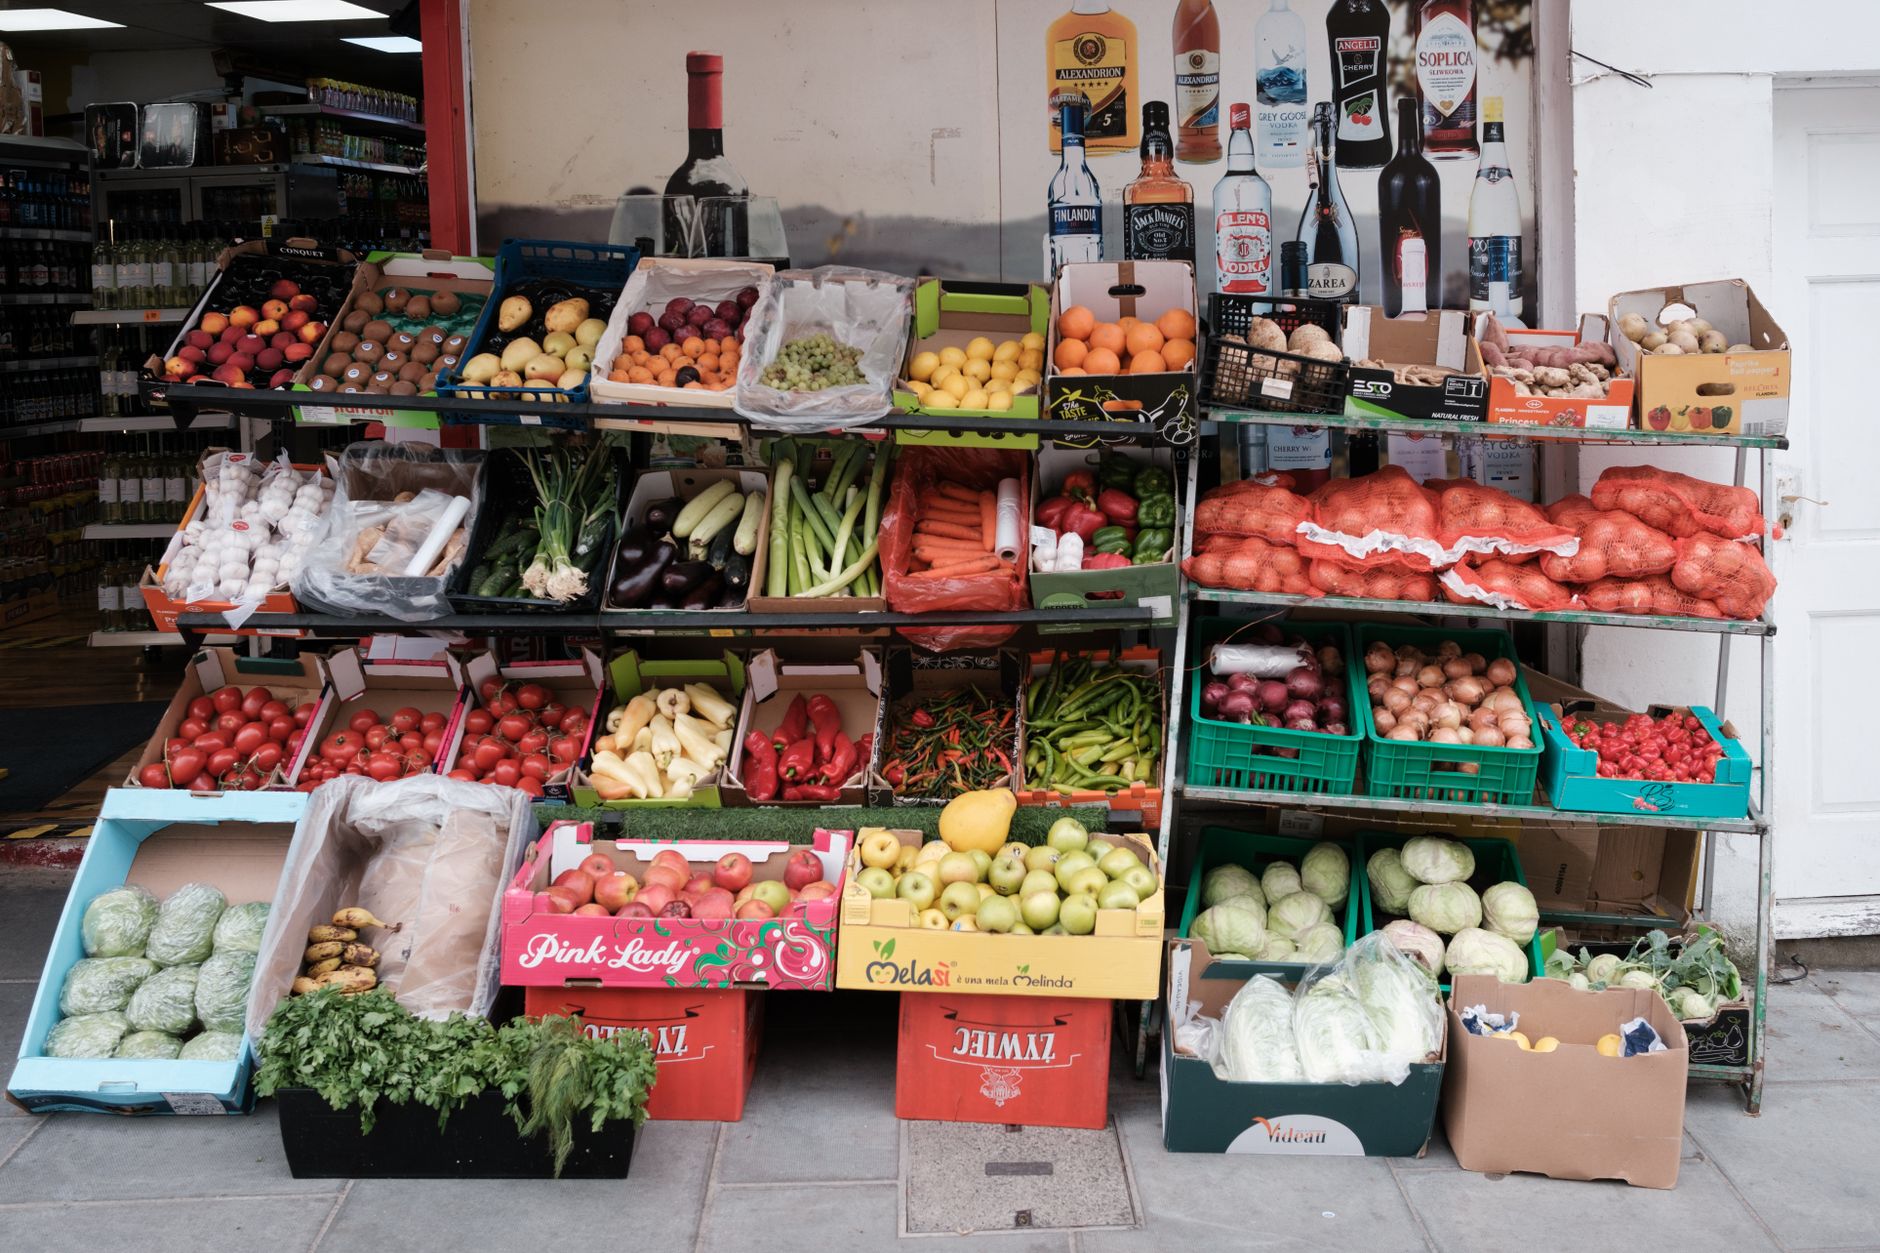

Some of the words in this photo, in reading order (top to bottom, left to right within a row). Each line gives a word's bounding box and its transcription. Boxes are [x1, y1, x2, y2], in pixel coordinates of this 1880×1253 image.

[1338, 40, 1377, 50] ANGELLI
[1419, 51, 1474, 67] SOPLICA
[1059, 67, 1121, 80] ALEXANDRION
[1177, 75, 1218, 85] ALEXANDRION
[1102, 113, 1112, 127] 5
[1259, 112, 1277, 122] GREY
[1279, 111, 1307, 121] GOOSE
[1054, 208, 1097, 223] FINLANDIA
[1133, 212, 1155, 231] JACK
[1154, 209, 1187, 230] DANIEL'S
[1221, 214, 1266, 226] GLEN'S
[279, 247, 324, 257] CONQUET
[1222, 262, 1266, 274] VODKA
[1307, 278, 1346, 289] ZAREA
[1062, 401, 1079, 410] The
[1059, 406, 1088, 420] TASTE
[1431, 412, 1459, 421] NATURAL
[1459, 413, 1481, 422] FRESH
[1498, 416, 1539, 425] Princess
[1273, 445, 1300, 453] CHERRY
[1487, 452, 1520, 460] VODKA
[519, 932, 607, 970] Pink
[607, 937, 692, 975] Lady
[866, 958, 950, 988] Melasì
[956, 975, 962, 984] è
[964, 976, 983, 986] una
[985, 975, 1009, 987] mela
[1012, 975, 1073, 989] Melinda
[953, 1027, 1057, 1064] ŻYWIEC
[1252, 1116, 1327, 1144] Videau
